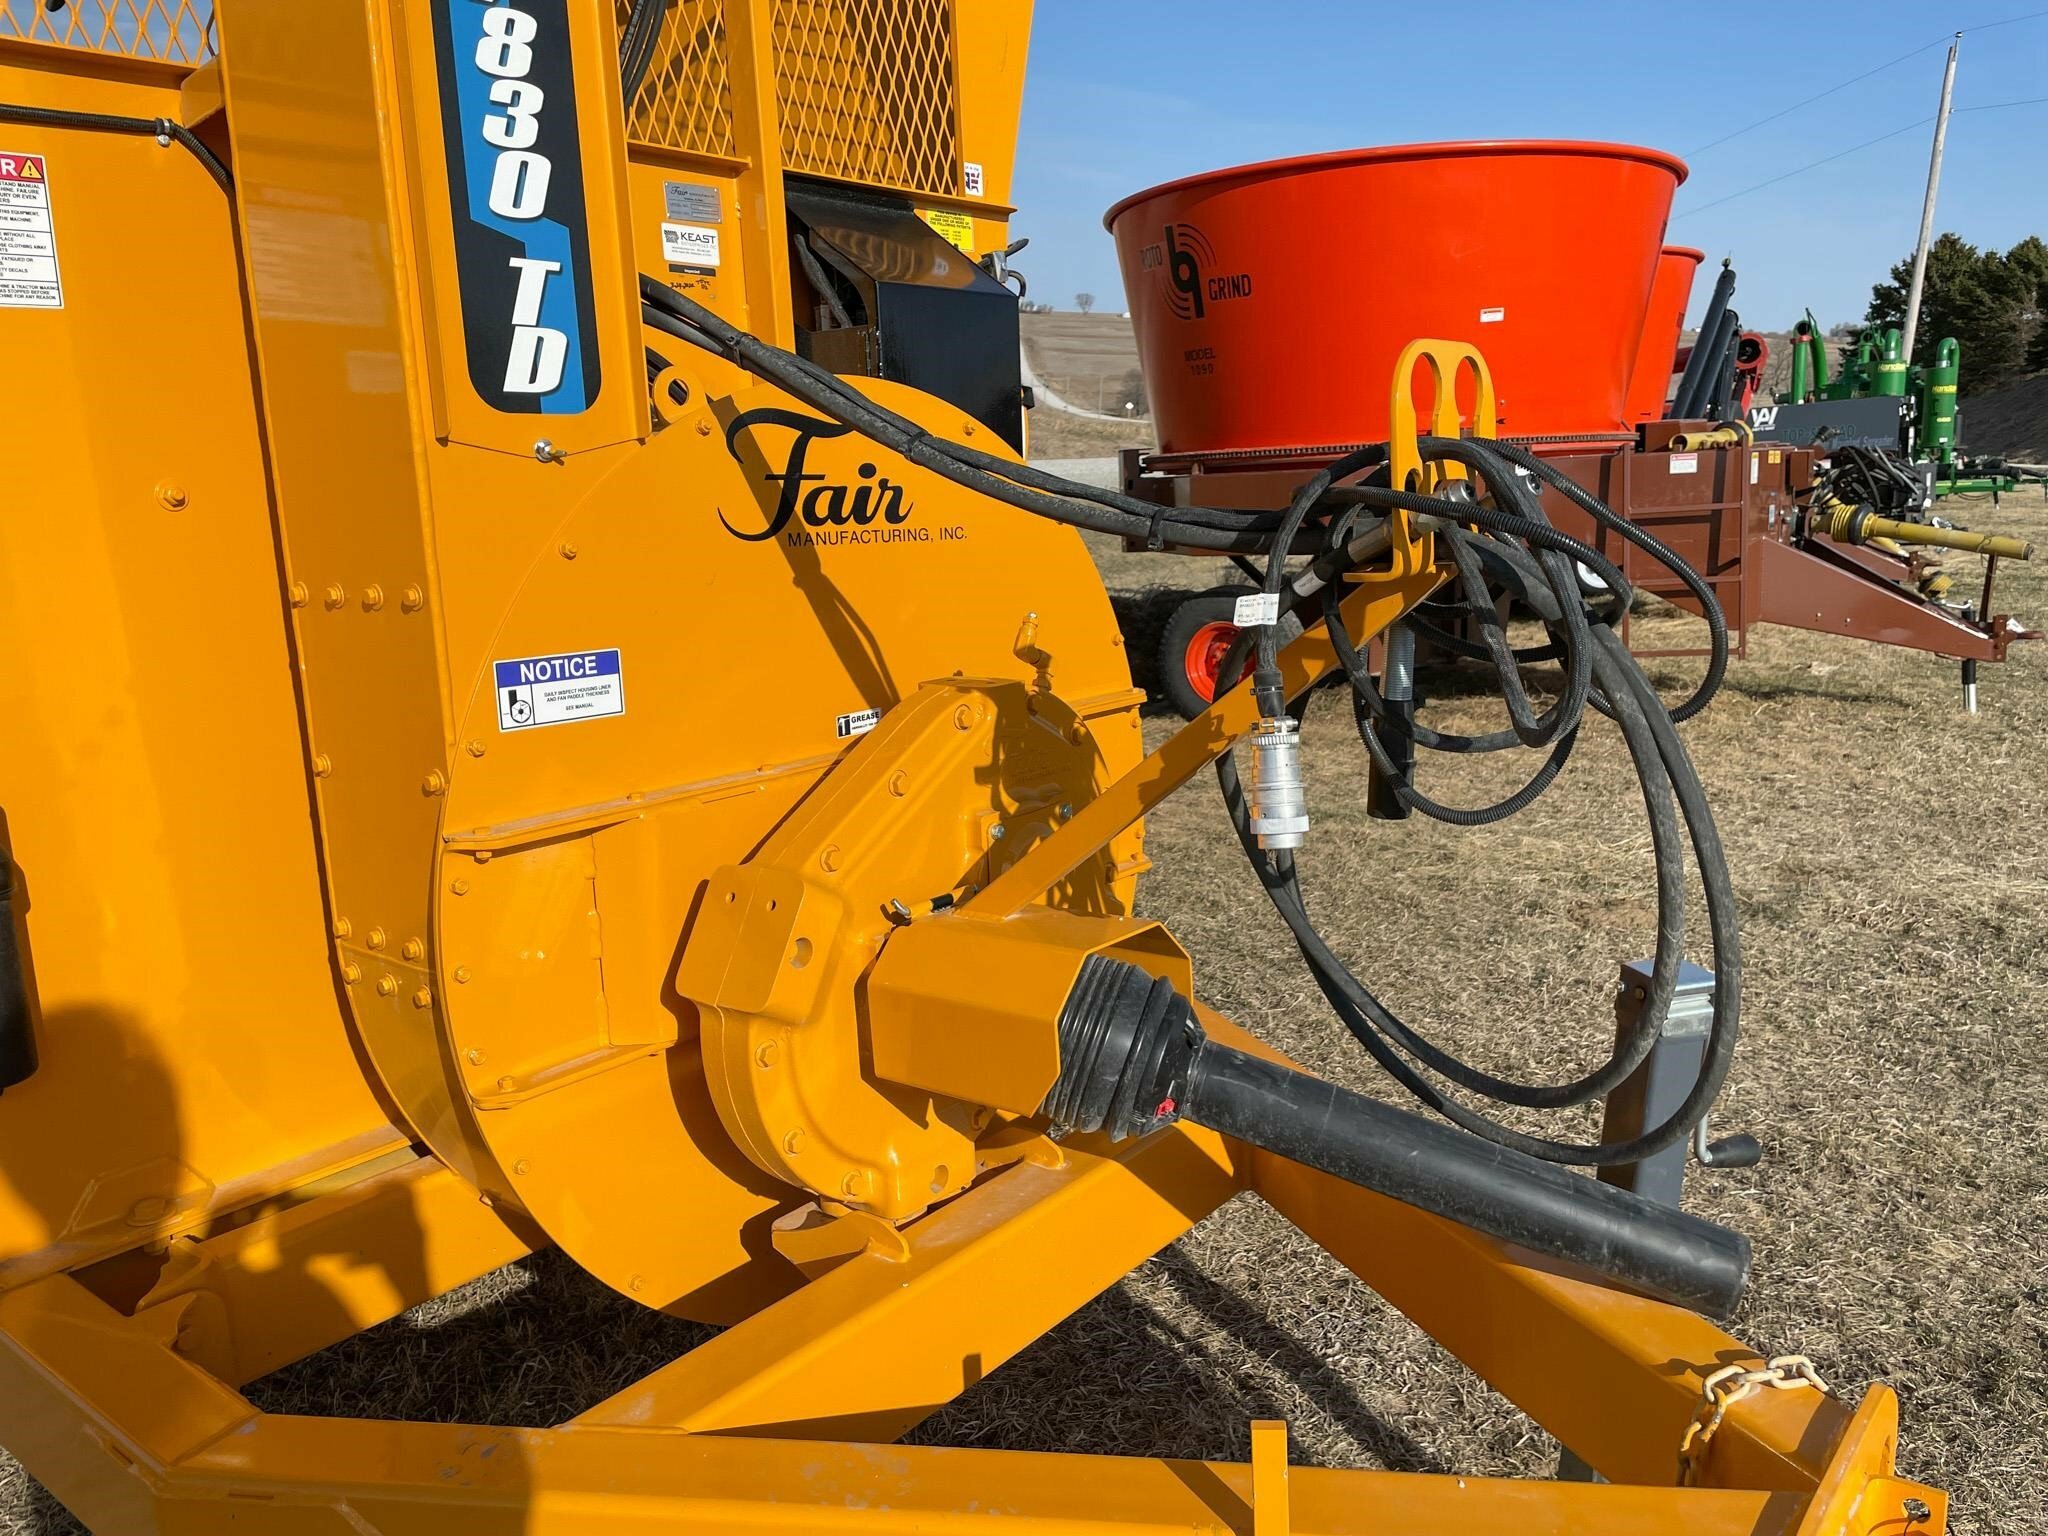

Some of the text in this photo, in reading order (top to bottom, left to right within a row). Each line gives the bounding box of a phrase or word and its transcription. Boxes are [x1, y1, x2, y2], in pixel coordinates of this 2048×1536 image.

[475, 0, 568, 393] 830 TD
[680, 231, 716, 244] KEAST
[1208, 274, 1252, 301] GRIND
[1184, 347, 1216, 361] MODEL
[717, 407, 914, 541] Fair
[787, 526, 968, 547] MANUFACTURING, INC.
[519, 655, 598, 683] NOTICE
[851, 711, 879, 723] GREASE
